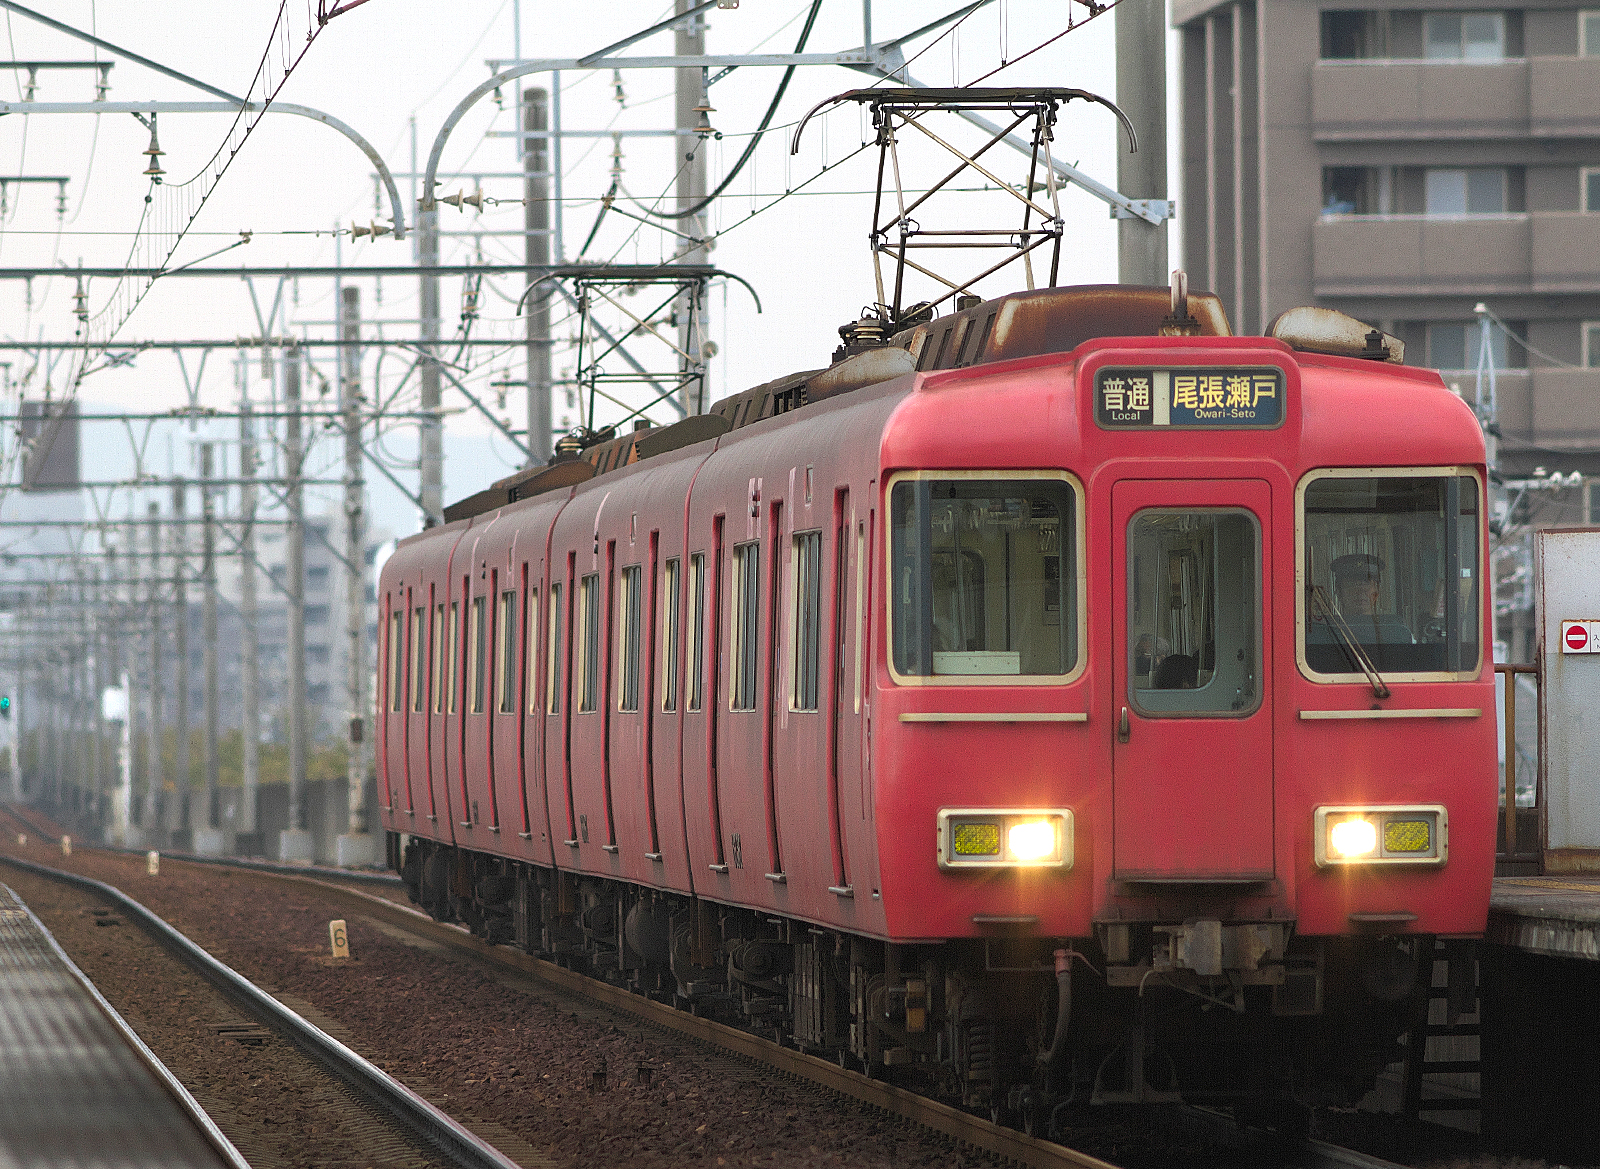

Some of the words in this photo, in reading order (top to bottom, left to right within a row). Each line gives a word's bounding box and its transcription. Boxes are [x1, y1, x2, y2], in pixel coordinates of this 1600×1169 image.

[1103, 378, 1150, 411] 普通
[1173, 375, 1277, 408] 尾張瀬戸
[1112, 411, 1140, 420] Local
[1194, 408, 1256, 419] Owari-Seto
[334, 928, 346, 948] 6
